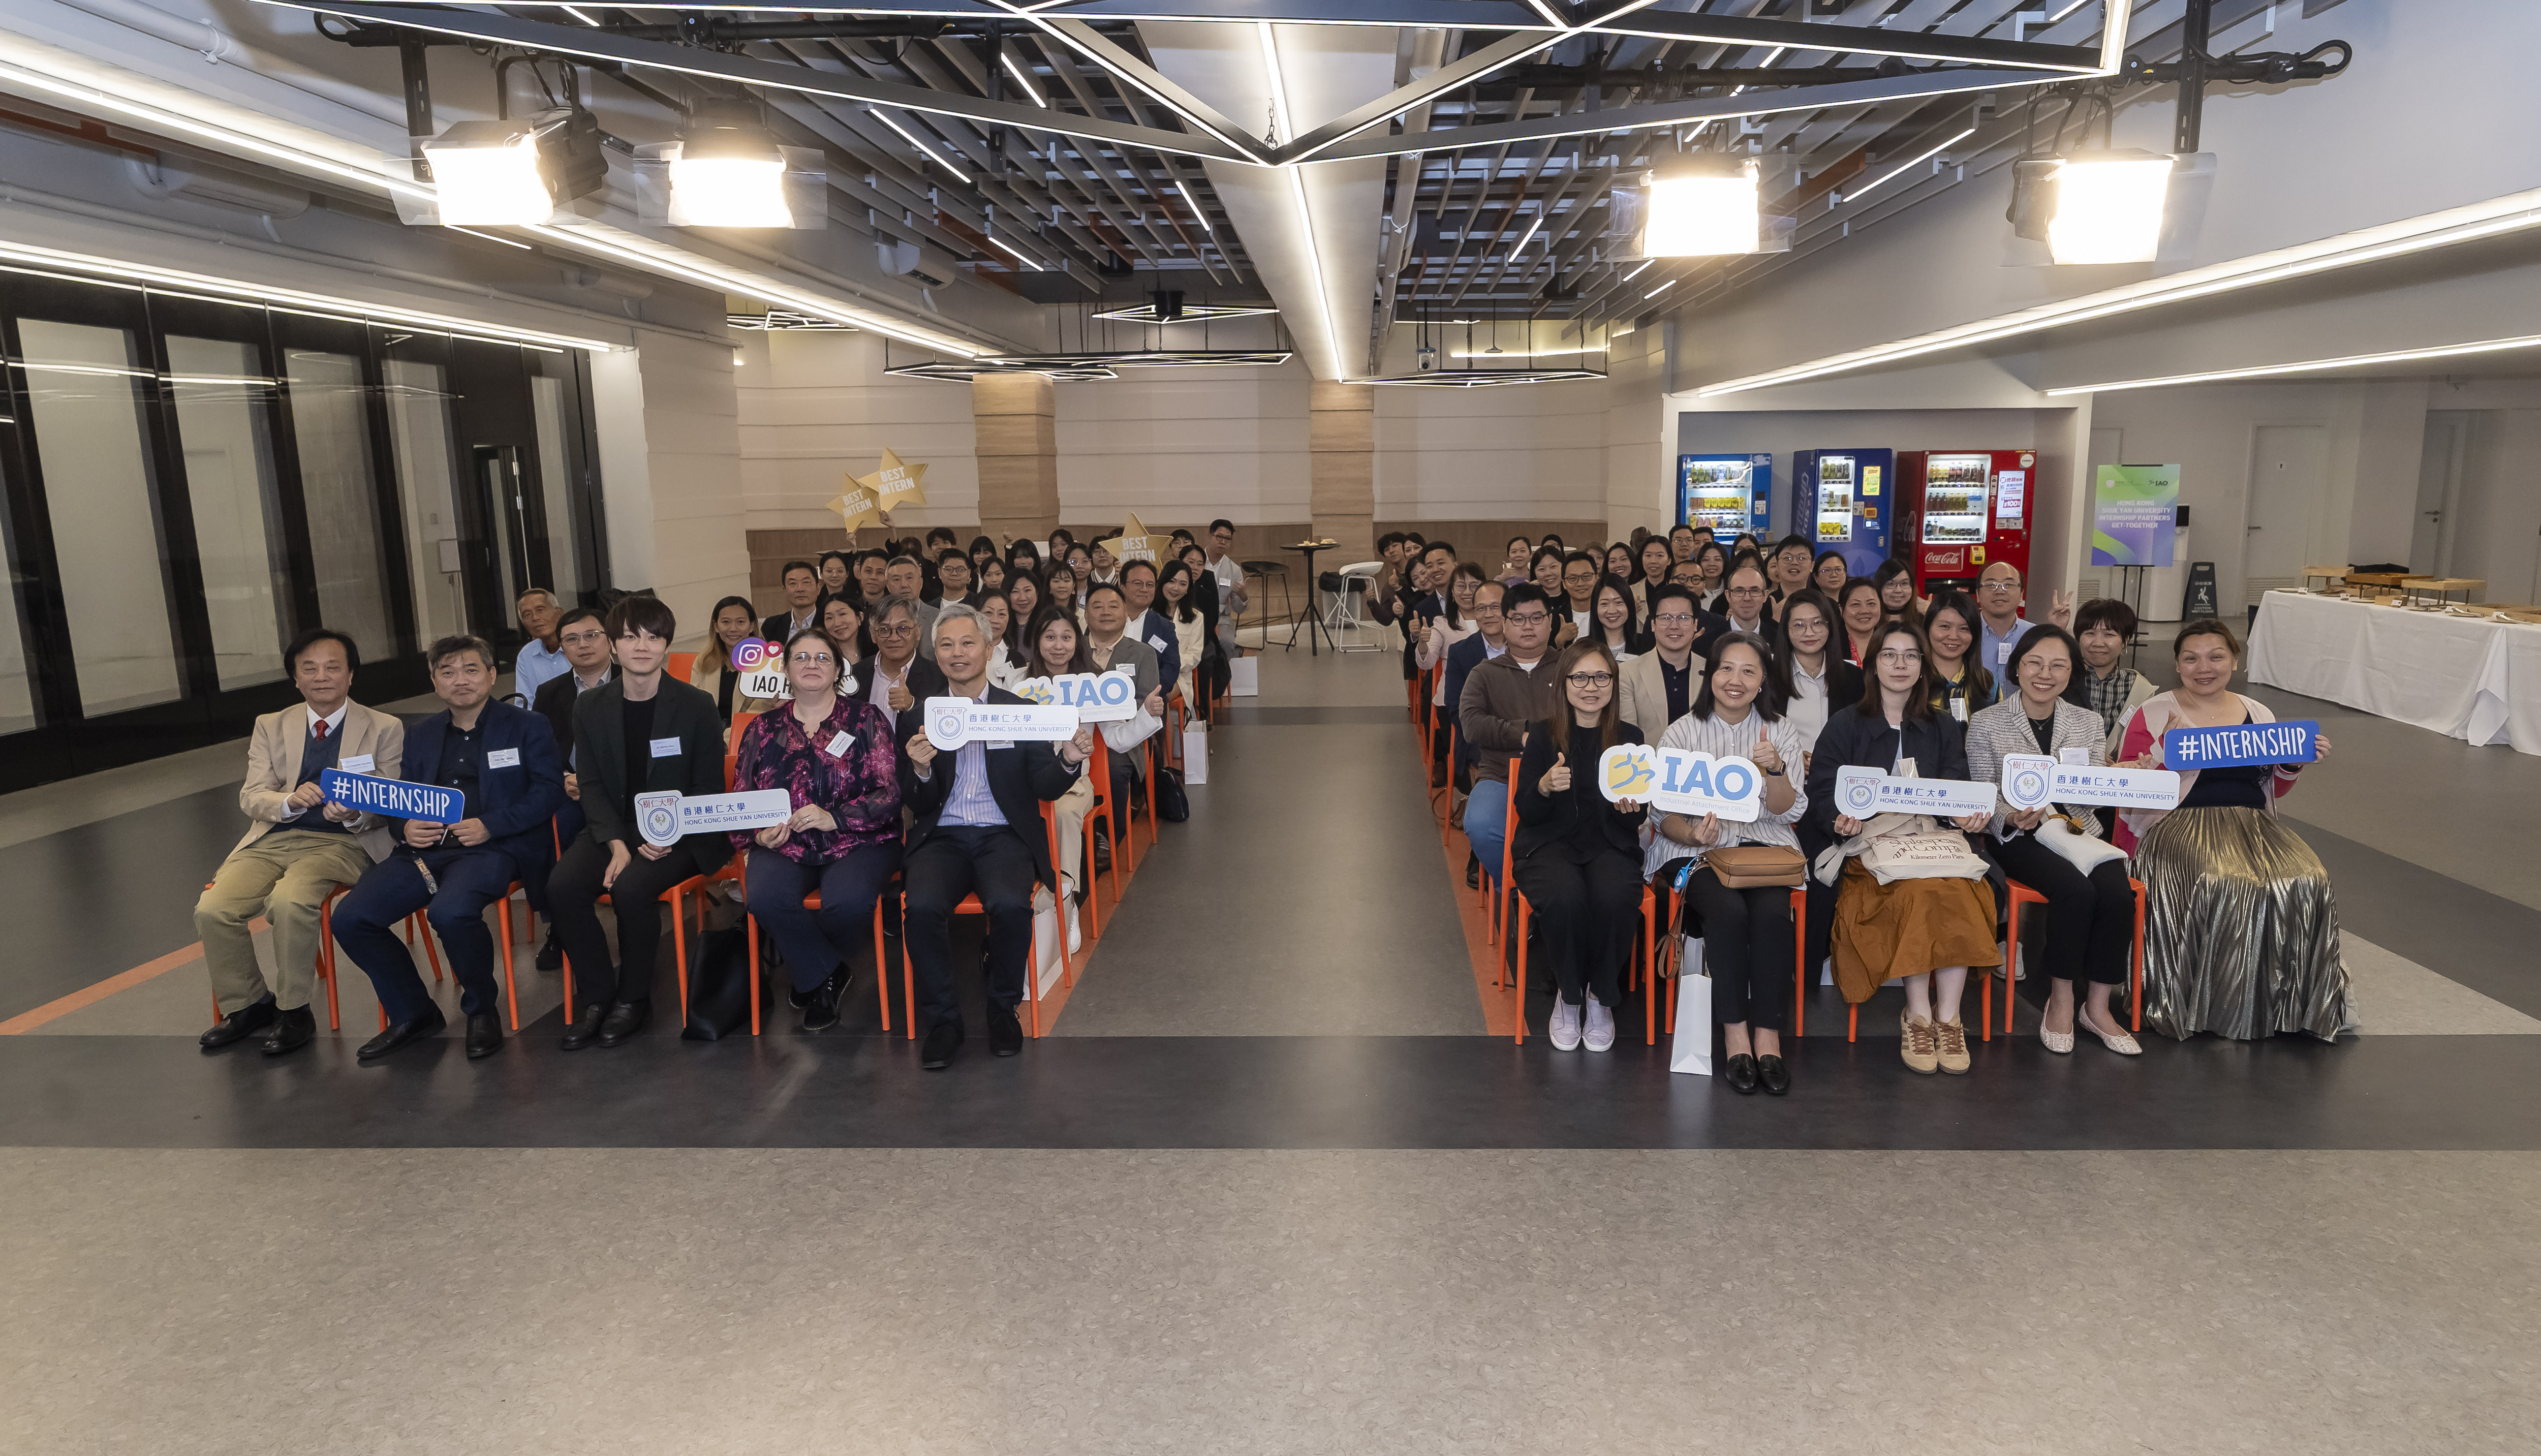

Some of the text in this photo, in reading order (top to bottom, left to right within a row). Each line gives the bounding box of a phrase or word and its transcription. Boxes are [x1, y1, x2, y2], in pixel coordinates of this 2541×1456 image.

[880, 467, 905, 482] BEST
[878, 477, 915, 495] INTERN
[843, 489, 863, 506] BEST
[843, 498, 873, 518] INTERN
[1122, 536, 1147, 550] BEST
[1119, 549, 1156, 564] INTERN
[1060, 677, 1128, 707] IAO
[969, 714, 1032, 723] 香港樹仁大學
[2178, 727, 2306, 761] #INTERNSHIP
[2013, 761, 2049, 771] 樹仁大學
[1662, 756, 1753, 800] IAO
[2057, 775, 2129, 788] 香港樹仁大學
[332, 777, 450, 818] #INTERNSHIP
[1882, 786, 1947, 798] 香港樹仁大學
[2136, 793, 2175, 801] UNIVERSITY
[643, 798, 674, 809] 樹仁大學
[684, 802, 746, 816] 香港樹仁大學
[1660, 796, 1750, 814] Industrial Attachment Office
[754, 812, 788, 820] UNIVERSITY
